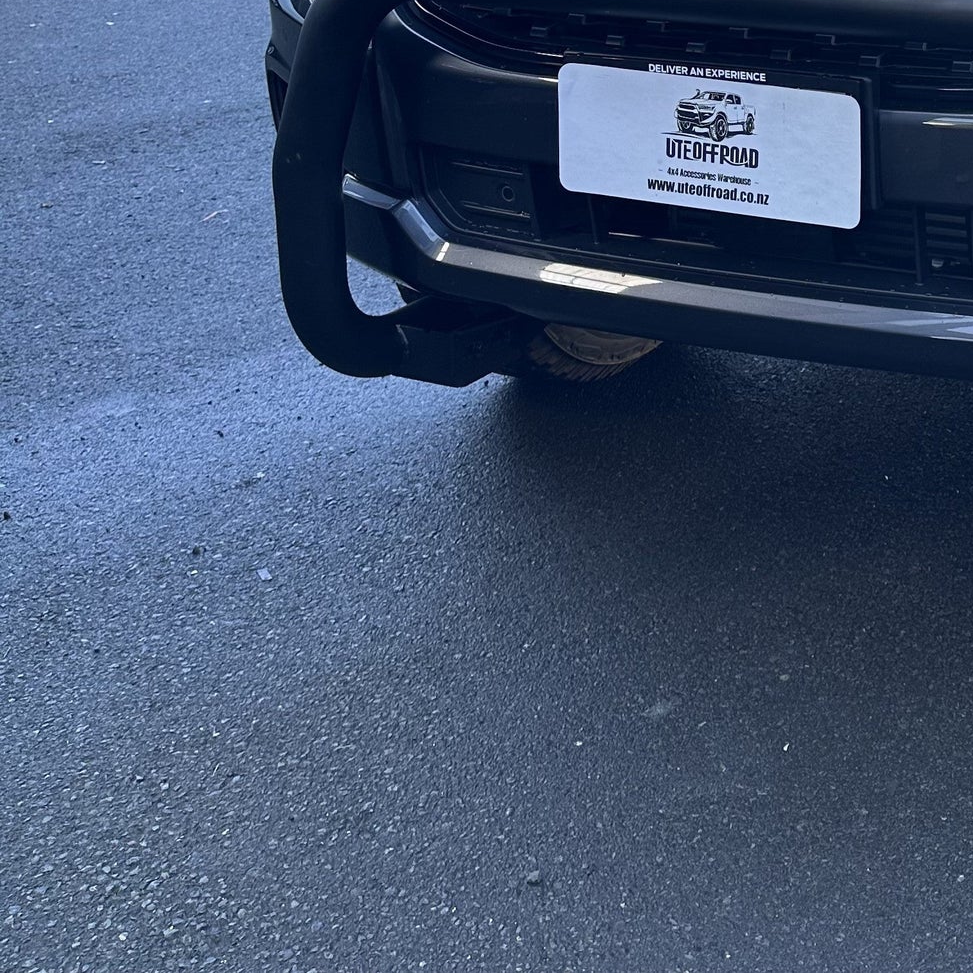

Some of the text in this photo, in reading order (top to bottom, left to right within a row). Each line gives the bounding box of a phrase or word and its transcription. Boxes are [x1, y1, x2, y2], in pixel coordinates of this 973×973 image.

[648, 63, 767, 82] DELIVER AN EXPERIENCE
[665, 137, 760, 169] UTEOFFROAD
[666, 167, 752, 187] 4x4 Accessories Warehouse
[647, 178, 770, 206] www.uteoffroad.co.nz
